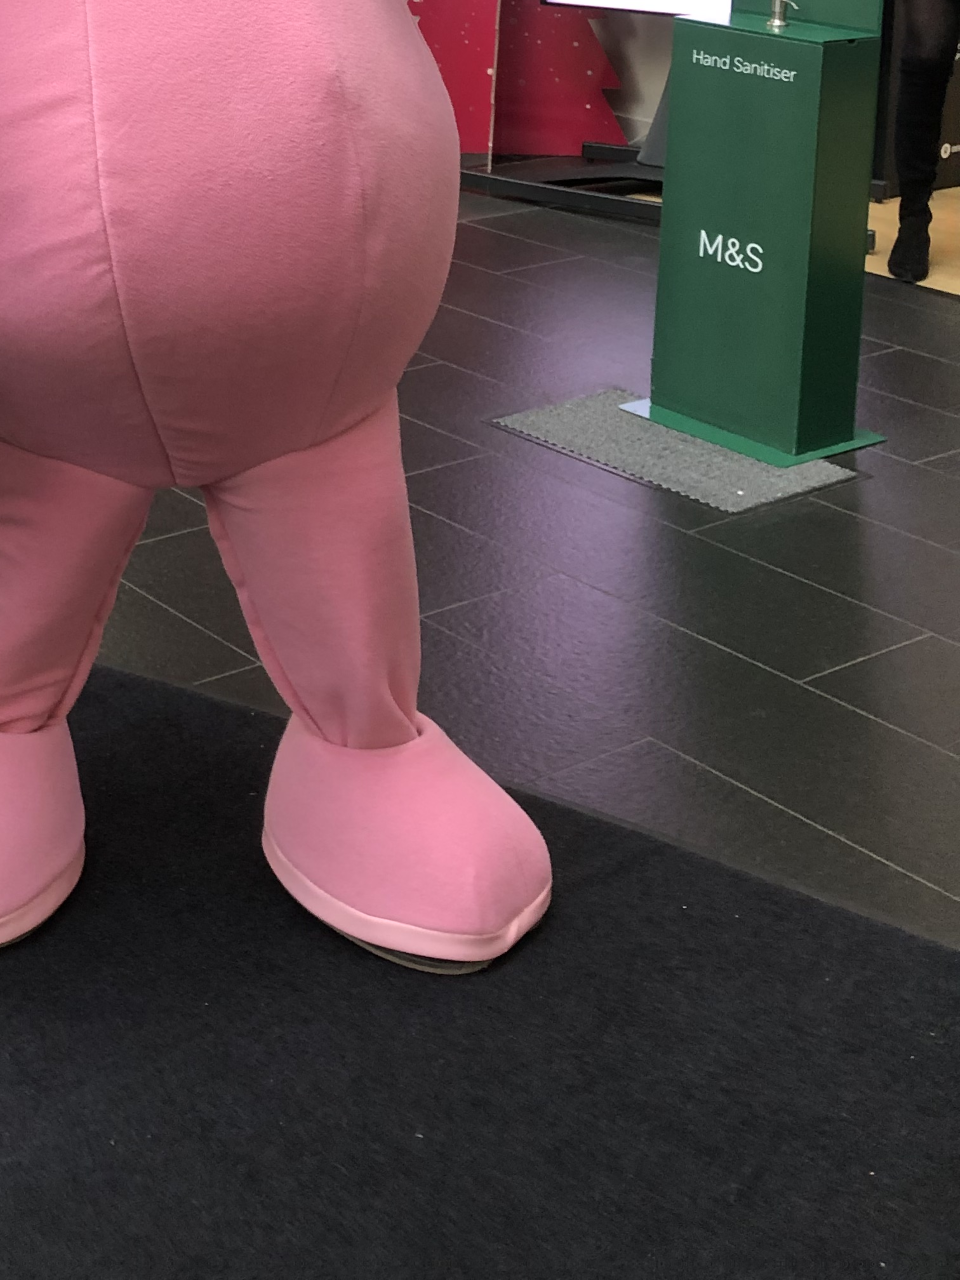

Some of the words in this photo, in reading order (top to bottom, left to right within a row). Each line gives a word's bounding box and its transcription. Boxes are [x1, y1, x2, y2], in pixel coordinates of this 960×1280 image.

[692, 49, 731, 70] Hand
[732, 57, 798, 82] Sanitiser
[699, 229, 765, 273] M&S
